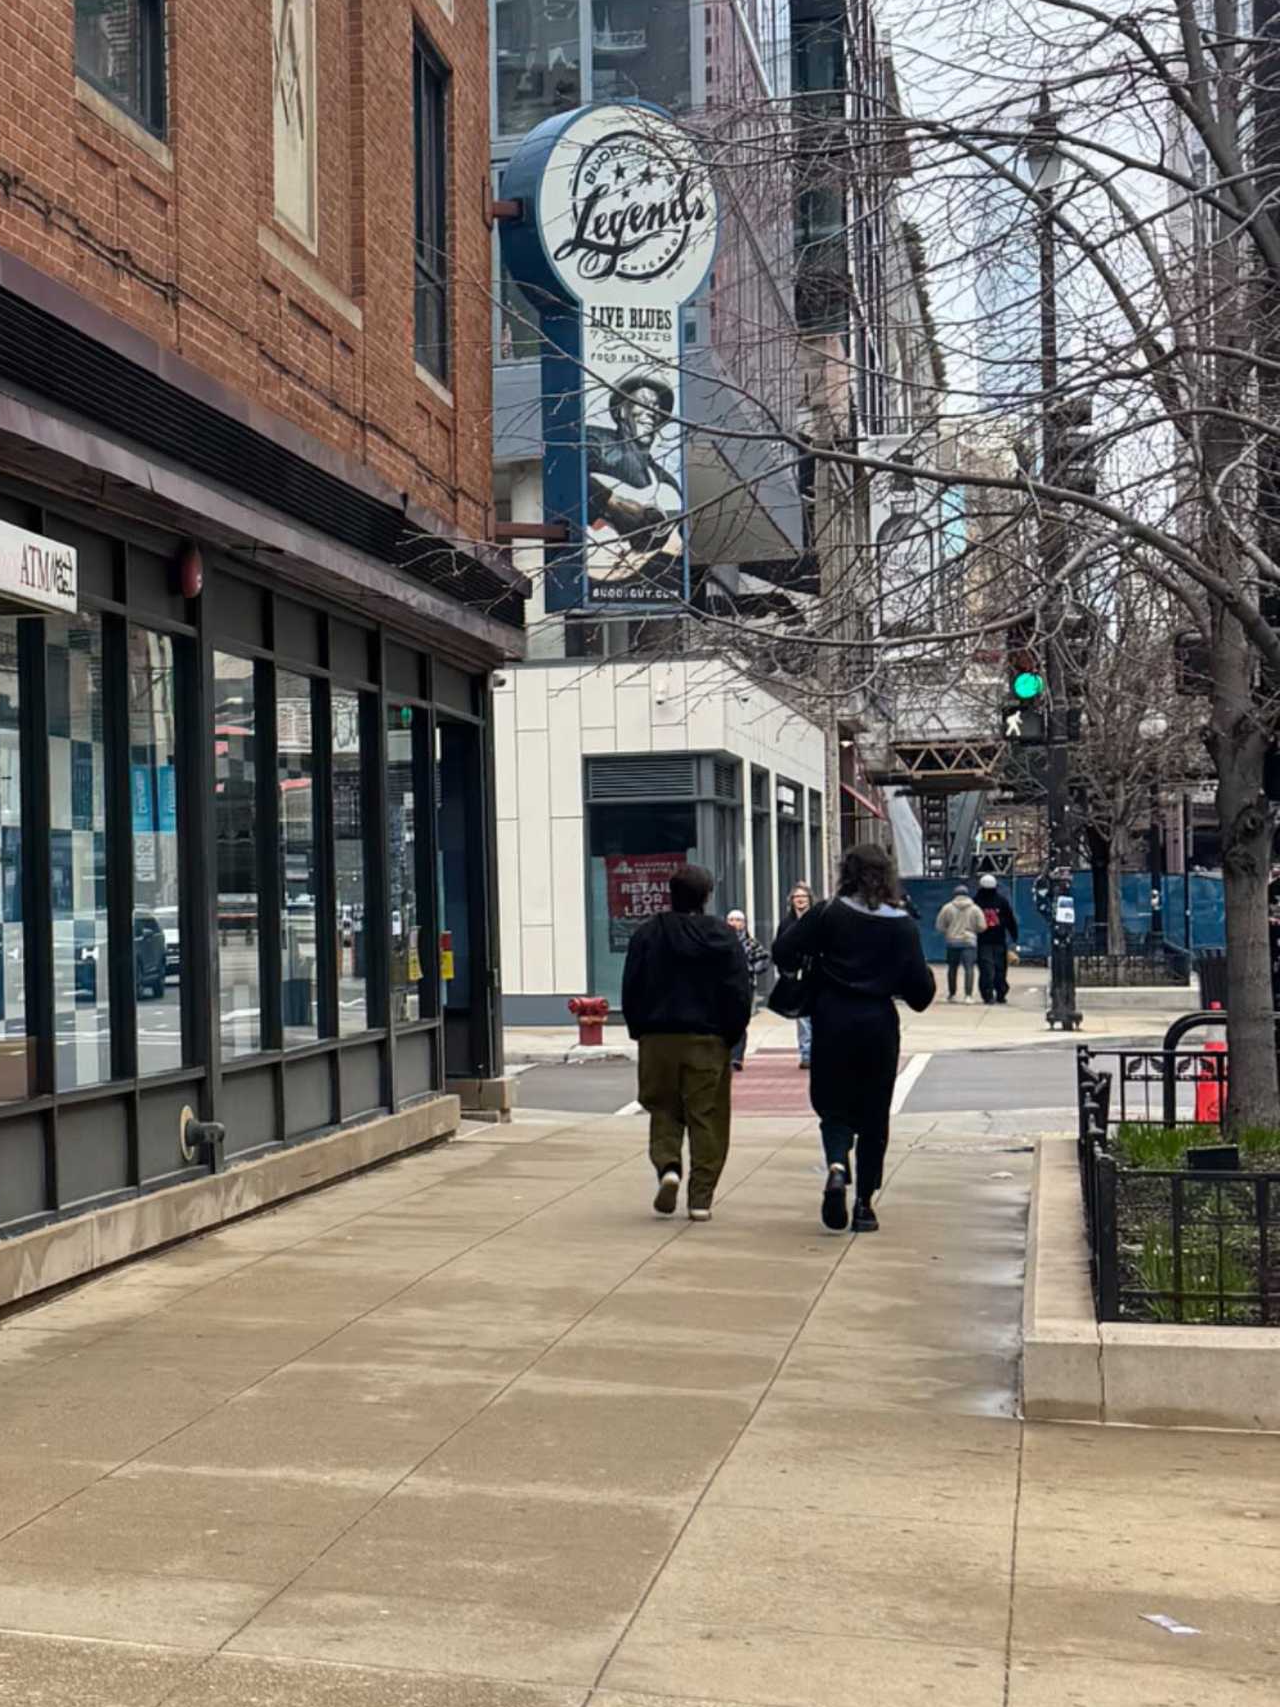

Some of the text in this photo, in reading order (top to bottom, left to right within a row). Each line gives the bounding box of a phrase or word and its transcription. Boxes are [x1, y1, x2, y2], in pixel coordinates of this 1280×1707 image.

[583, 140, 631, 185] BUDDY
[553, 170, 707, 280] Legends
[620, 237, 679, 271] CHICAGO
[589, 306, 672, 330] LIVE BLUES
[19, 543, 51, 593] ATM
[592, 587, 680, 599] BUDDGUY.COM
[631, 894, 663, 905] FOR
